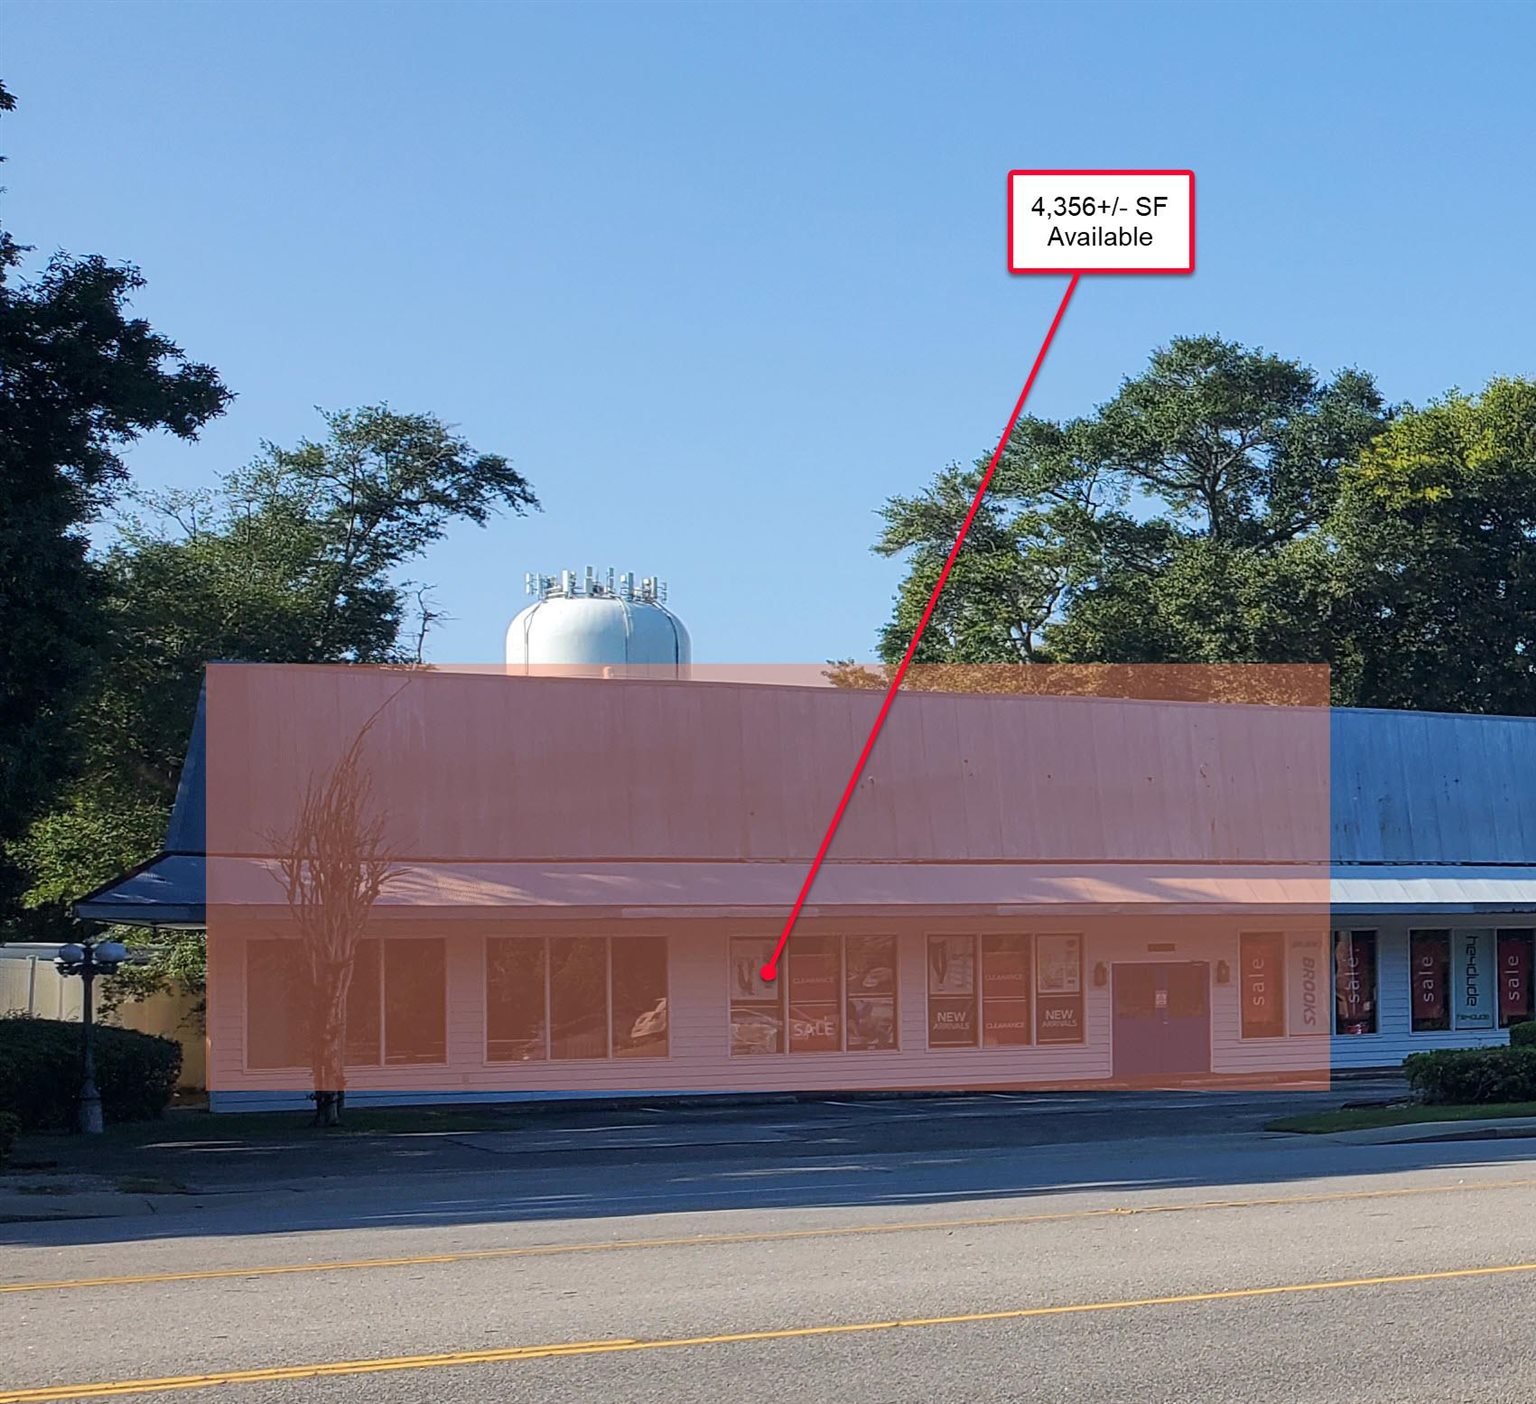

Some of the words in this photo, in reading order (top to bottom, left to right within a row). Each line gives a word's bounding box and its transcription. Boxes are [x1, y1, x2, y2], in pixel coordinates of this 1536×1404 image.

[1248, 958, 1265, 1006] sale
[1302, 956, 1316, 1026] BROOKS
[1345, 957, 1360, 1004] sale
[1419, 956, 1435, 1003] sale
[1504, 955, 1520, 1001] sale
[793, 1021, 835, 1036] SALE
[937, 1011, 966, 1023] NEW
[1045, 1009, 1074, 1020] NEW
